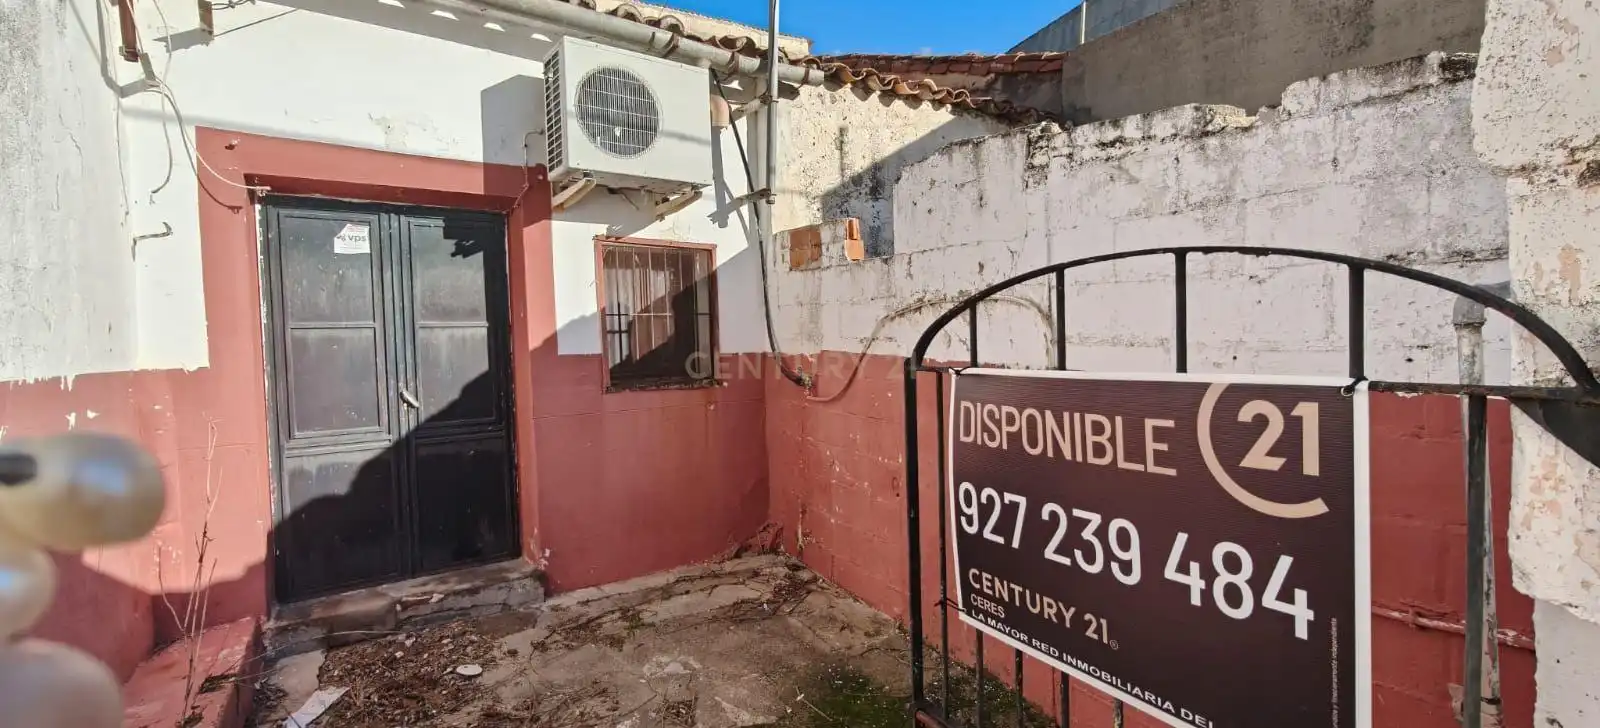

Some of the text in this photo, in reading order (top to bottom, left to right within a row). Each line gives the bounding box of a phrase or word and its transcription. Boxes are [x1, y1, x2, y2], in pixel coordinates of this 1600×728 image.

[959, 400, 1178, 477] DISPONIBLE
[958, 481, 1315, 641] 927 239 484
[968, 568, 1076, 628] CENTURY
[970, 593, 1006, 619] CERES
[971, 610, 986, 622] LA
[987, 616, 1029, 644] MAYOR
[1031, 637, 1060, 658] RED
[1062, 652, 1176, 713] INMOBILIARIA
